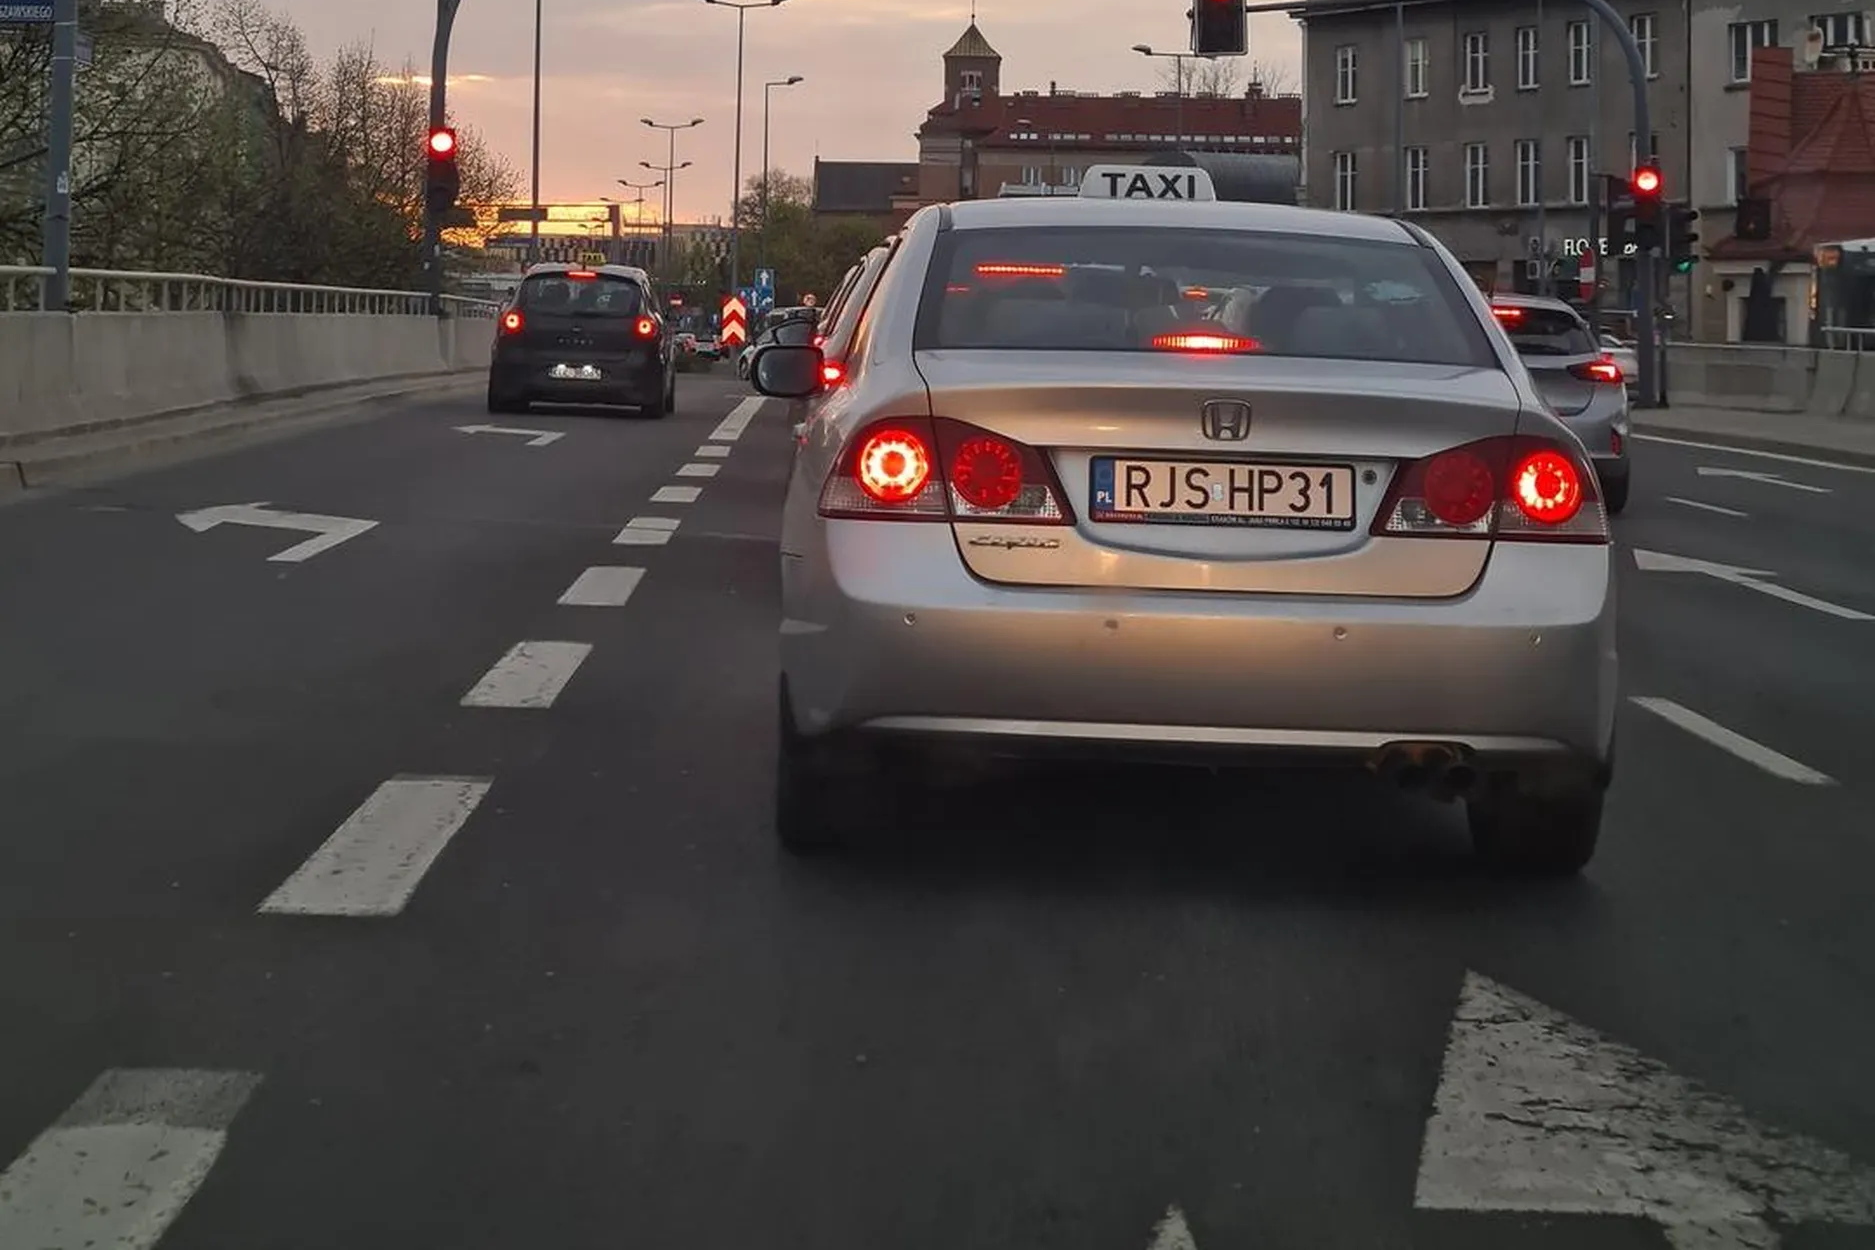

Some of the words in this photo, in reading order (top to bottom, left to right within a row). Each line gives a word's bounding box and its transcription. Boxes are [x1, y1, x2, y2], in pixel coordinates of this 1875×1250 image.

[1101, 173, 1195, 199] TAXI
[1096, 490, 1113, 504] PL
[1125, 464, 1211, 509] RJS
[1228, 468, 1333, 514] HP31
